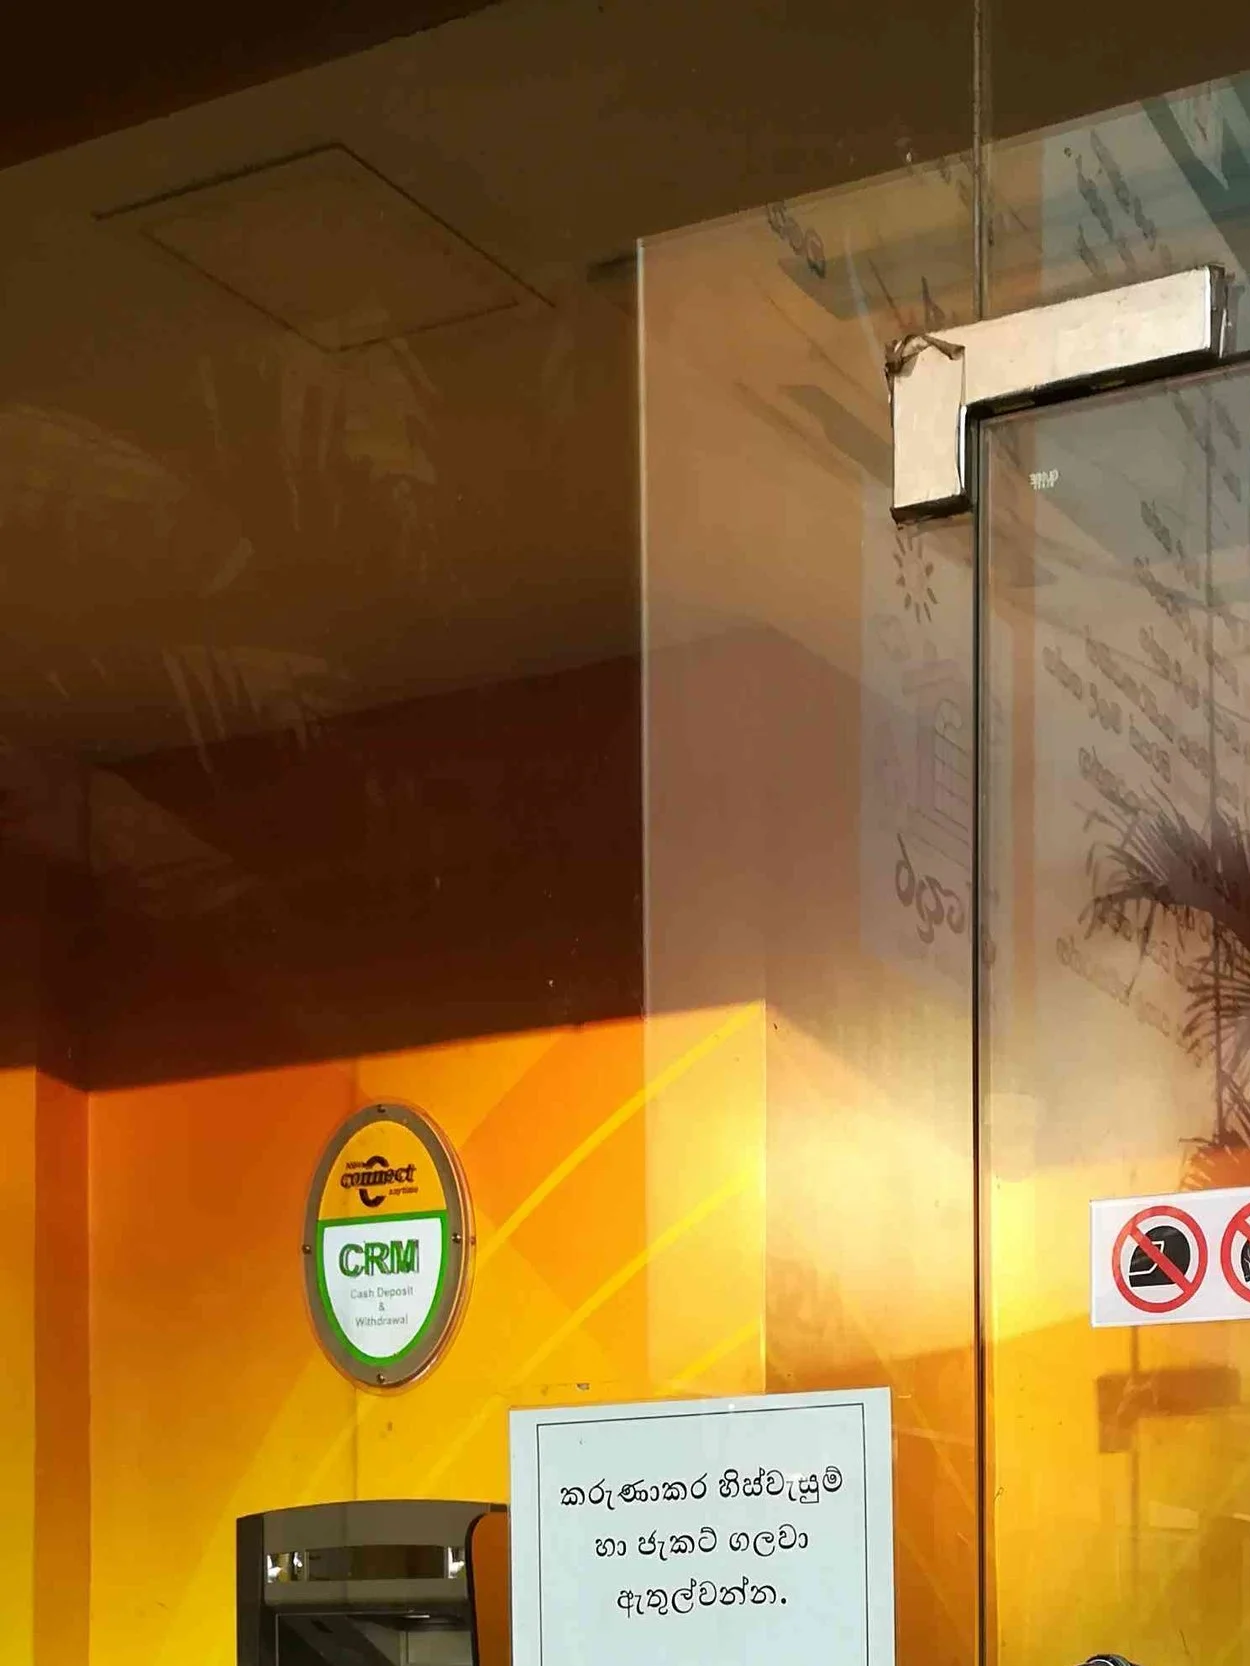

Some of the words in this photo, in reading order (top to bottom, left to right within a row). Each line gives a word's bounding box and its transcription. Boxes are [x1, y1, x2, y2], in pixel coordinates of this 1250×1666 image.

[340, 1163, 417, 1189] connect
[338, 1238, 420, 1277] CRM
[350, 1287, 375, 1300] Cash
[376, 1286, 414, 1301] Deposit
[378, 1302, 386, 1312] &
[355, 1313, 409, 1327] Withdrawal
[559, 1472, 708, 1511] කරුණාකර
[718, 1465, 844, 1505] හිස්වැසුම්
[594, 1536, 627, 1558] හා
[637, 1526, 718, 1562] ජැකට්
[728, 1523, 810, 1558] ගලවා
[616, 1576, 788, 1619] ඇතුල්වන්න.
